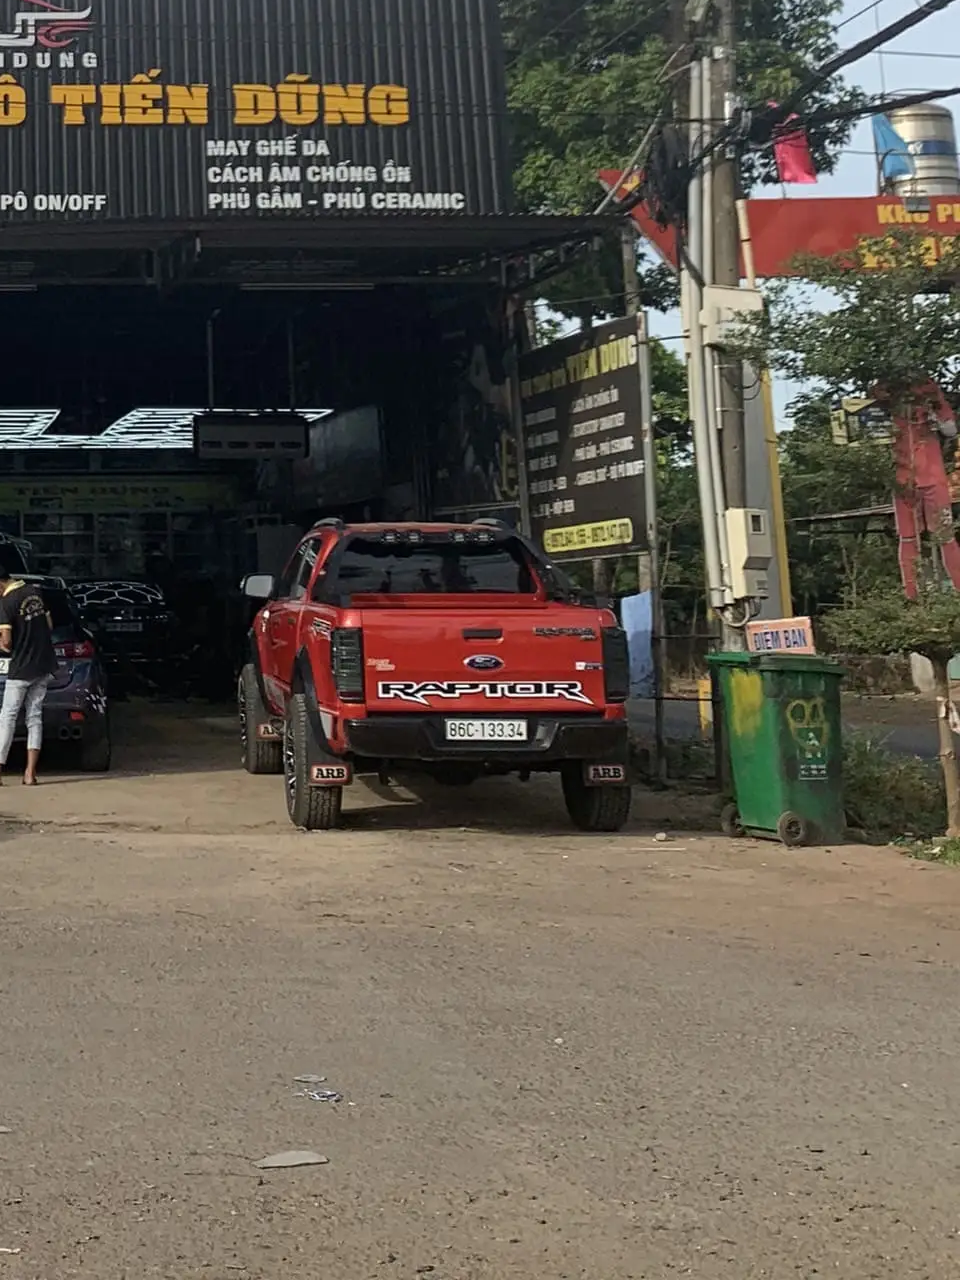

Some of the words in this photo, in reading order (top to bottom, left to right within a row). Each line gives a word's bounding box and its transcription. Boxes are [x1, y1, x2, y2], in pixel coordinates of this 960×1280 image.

[50, 69, 209, 126] TIẾN
[233, 72, 410, 126] DŨNG
[207, 140, 249, 157] MAY
[256, 134, 297, 157] GHẾ
[303, 140, 330, 157] DA
[208, 163, 263, 183] CÁCH
[268, 162, 301, 183] ÂM
[306, 160, 377, 183] CHỐNG
[0, 191, 28, 211] PÔ
[33, 194, 107, 212] ON/OFF
[208, 187, 250, 210] PHỦ
[256, 185, 302, 210] GẦM
[323, 187, 366, 210] PHỦ
[371, 192, 465, 210] CERAMIC
[378, 681, 594, 707] RAPTOR
[449, 723, 524, 738] 86C-133.34
[315, 768, 345, 779] ARB
[592, 767, 622, 779] ARB
